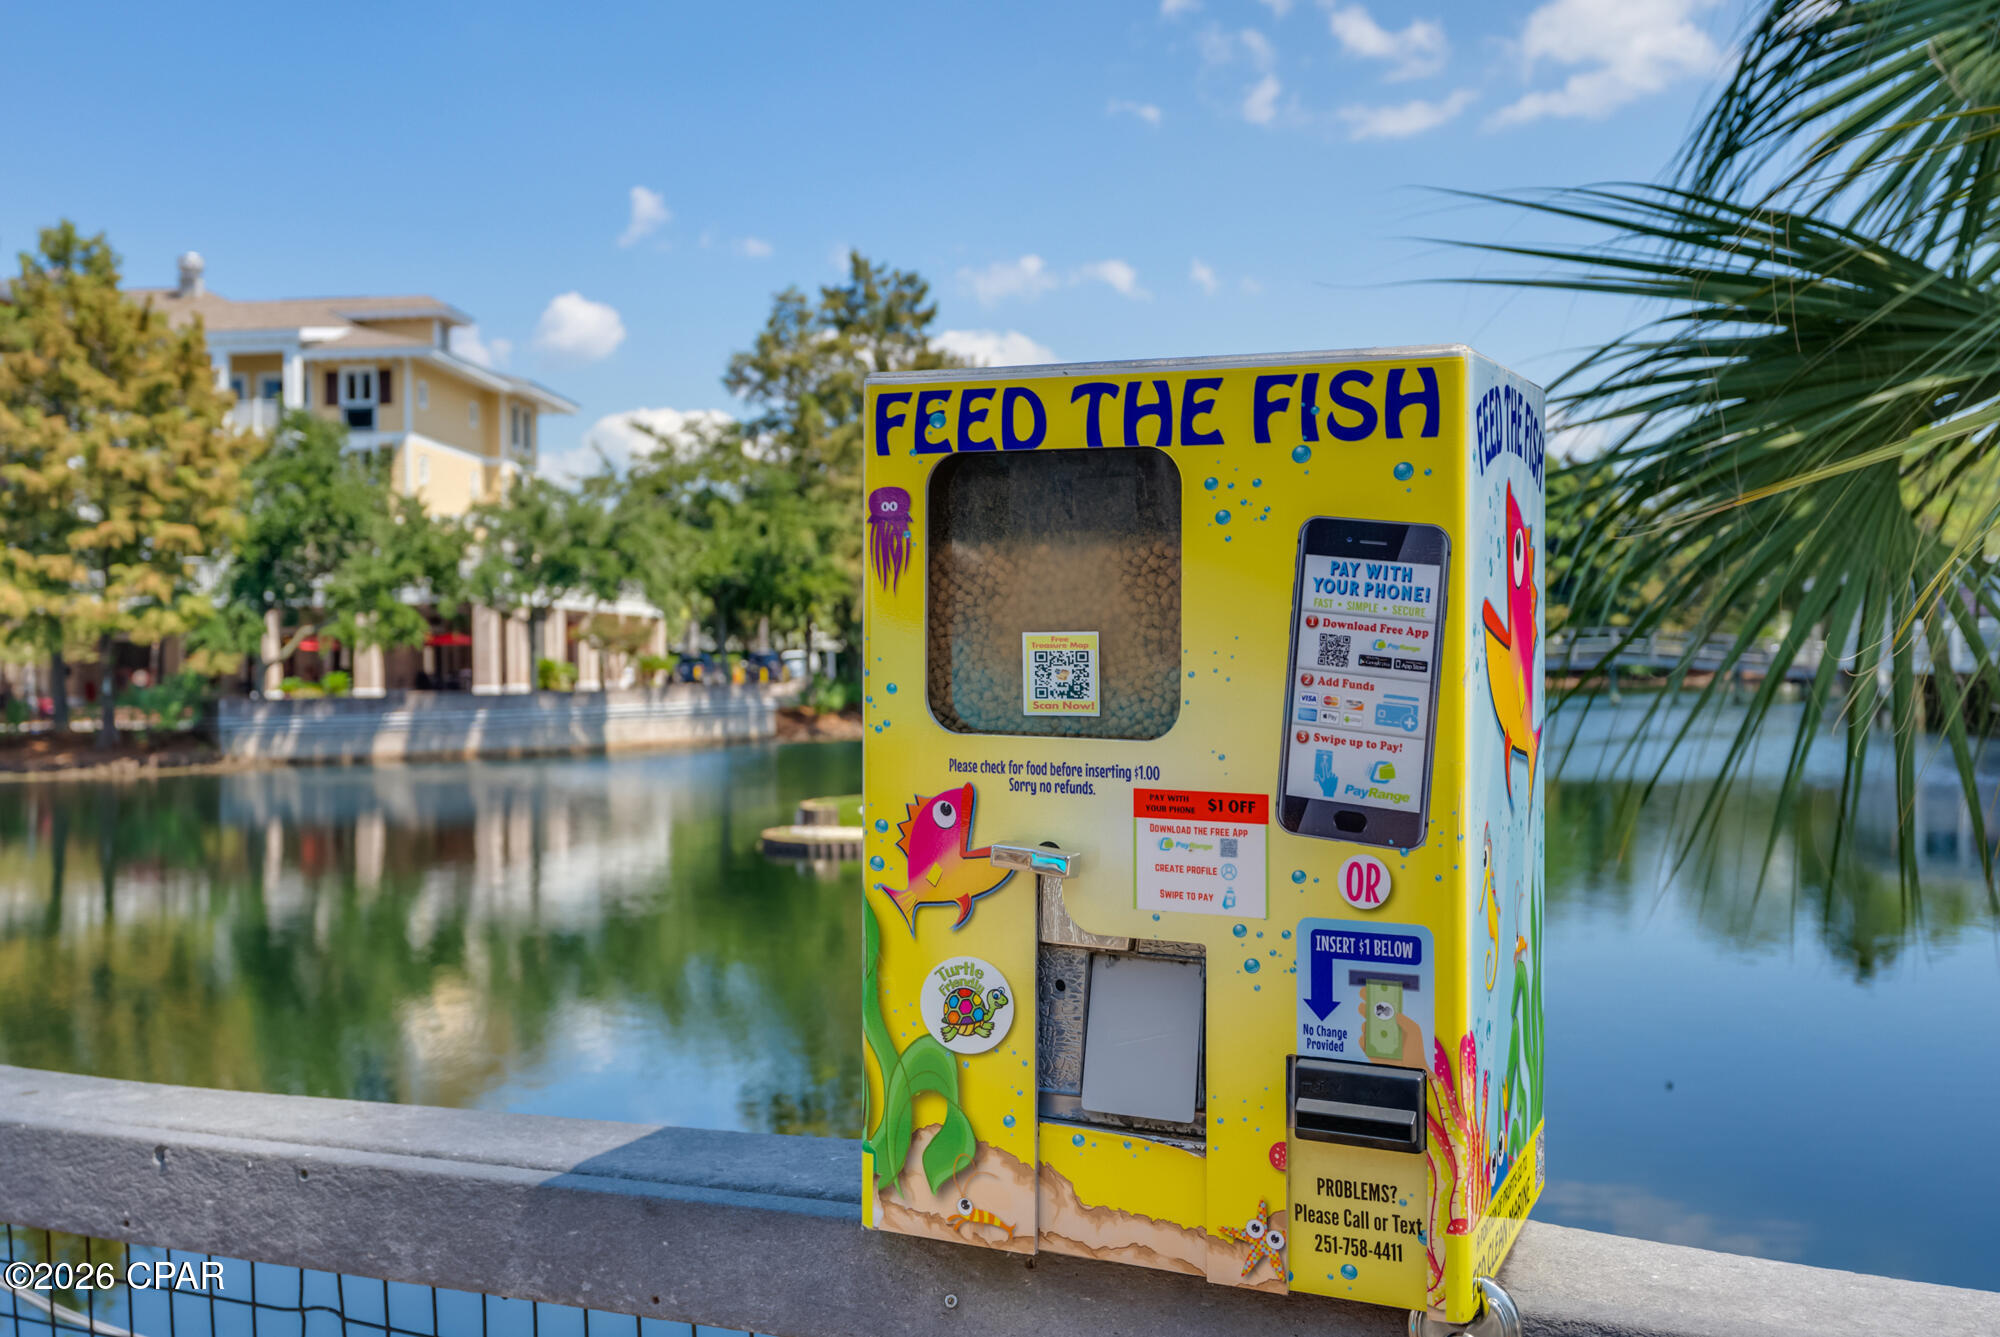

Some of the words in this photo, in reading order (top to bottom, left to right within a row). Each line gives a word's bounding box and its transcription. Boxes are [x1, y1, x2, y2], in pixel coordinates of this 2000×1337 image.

[875, 387, 1047, 456] FEED
[1071, 377, 1224, 448] THE
[1253, 367, 1440, 443] FISH
[1476, 386, 1502, 476] FEED
[1504, 384, 1523, 458] THE
[1525, 401, 1544, 494] FISH
[1330, 560, 1360, 578] PAY
[1366, 563, 1413, 583] WITH
[1313, 576, 1359, 597] YOUR
[1364, 582, 1431, 603] PHONE!
[1313, 597, 1333, 609] FAST
[1346, 600, 1379, 613] SIMPLE
[1392, 605, 1426, 617] SECURE
[1322, 618, 1377, 632] Download
[1379, 623, 1403, 635] Free
[1406, 626, 1429, 639] App
[1401, 662, 1412, 670] App
[1413, 663, 1427, 671] Store
[1318, 676, 1339, 687] Add
[1342, 679, 1375, 691] Funds
[1033, 701, 1059, 710] Scan
[1063, 701, 1095, 710] Now!
[1301, 695, 1317, 703] VISA
[1327, 713, 1337, 722] Pay
[1313, 733, 1346, 747] Swipe
[1349, 739, 1363, 749] up
[1366, 740, 1377, 749] to
[1380, 741, 1403, 754] Pay!
[948, 758, 978, 774] Please
[980, 760, 1005, 774] check
[1008, 760, 1024, 775] for
[1026, 762, 1047, 776] food
[1050, 762, 1083, 777] before
[1085, 763, 1132, 782] inserting
[1134, 765, 1160, 781] $1.00
[1009, 777, 1037, 796] Sorry
[1039, 782, 1052, 793] no
[1054, 779, 1096, 795] refunds.
[1344, 784, 1410, 804] PayRange
[1149, 793, 1166, 801] PAY
[1167, 794, 1189, 803] WITH
[1208, 798, 1223, 813] $1
[1228, 799, 1256, 814] OFF
[1145, 804, 1167, 812] YOUR
[1169, 805, 1195, 815] PHONE
[1149, 823, 1191, 835] DOWNLOAD
[1194, 826, 1208, 836] THE
[1210, 827, 1229, 837] FREE
[1154, 863, 1184, 874] CREATE
[1186, 866, 1218, 876] PROFILE
[1346, 861, 1380, 904] OR
[1159, 888, 1184, 900] SWIPE
[1187, 891, 1196, 900] TO
[1198, 892, 1214, 902] PAY
[1316, 935, 1356, 954] INSERT
[1359, 939, 1370, 955] $1
[1374, 940, 1413, 959] BELOW
[934, 961, 984, 982] Turtle
[1303, 1024, 1314, 1036] No
[1316, 1025, 1348, 1041] Change
[1306, 1038, 1344, 1052] Provided
[1317, 1177, 1398, 1204] PROBLEMS?
[1295, 1203, 1339, 1226] Please
[1344, 1209, 1369, 1230] Call
[1374, 1216, 1388, 1232] or
[1392, 1214, 1423, 1236] Text
[1314, 1234, 1403, 1263] 251-758-4411
